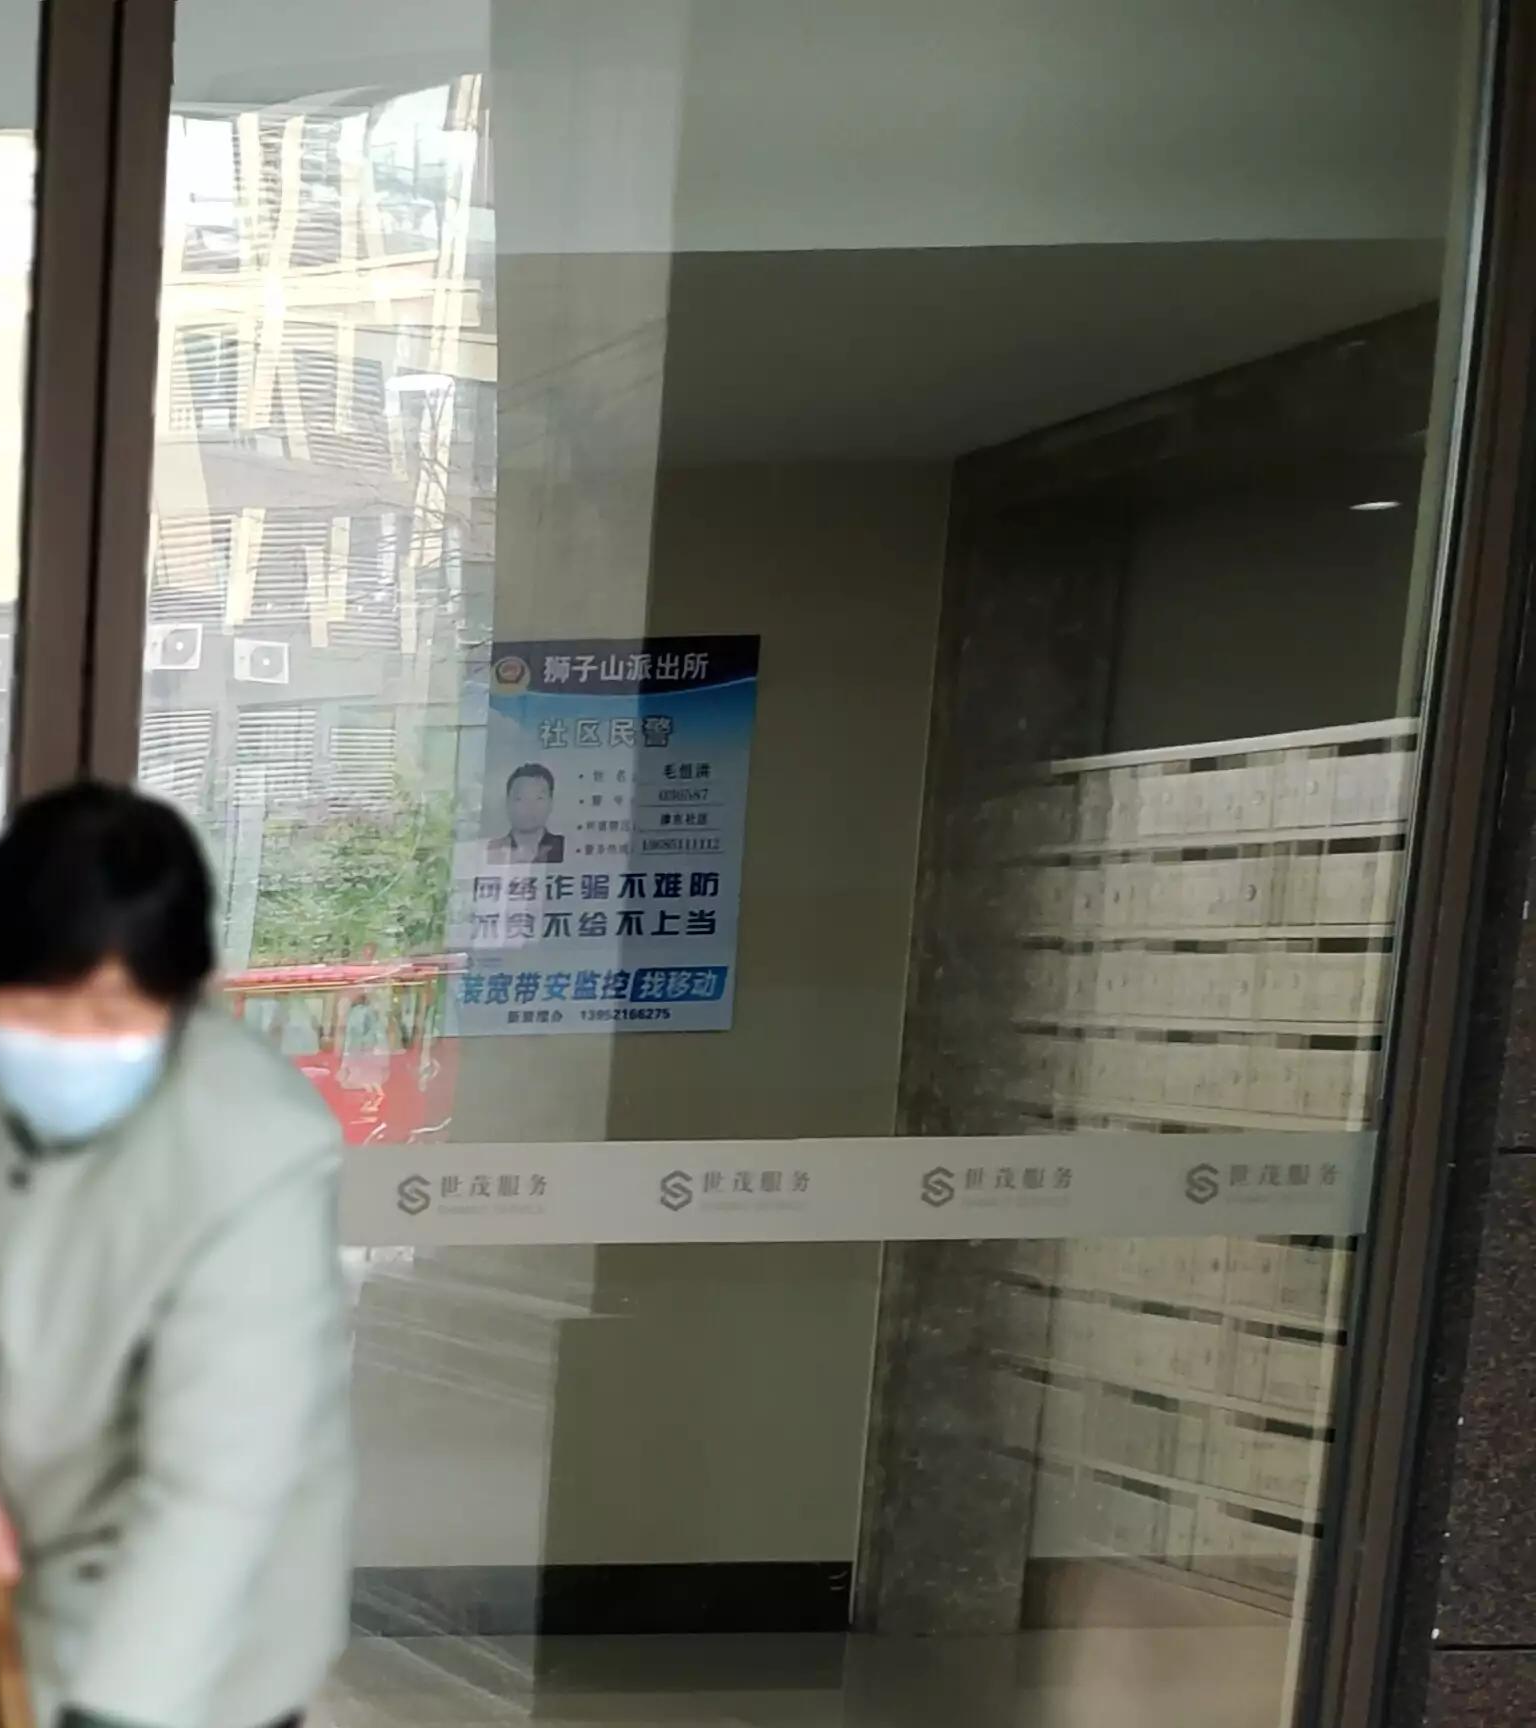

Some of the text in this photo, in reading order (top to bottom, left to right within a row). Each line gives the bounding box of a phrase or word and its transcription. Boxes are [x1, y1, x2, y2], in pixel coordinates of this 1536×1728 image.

[543, 651, 710, 684] 狮子山派出所
[539, 715, 674, 749] 社区民警
[472, 871, 721, 902] 网络诈骗不难防
[469, 908, 718, 939] 不贪不给不上当
[458, 968, 717, 1004] 装宽带安监控 找移动
[440, 1173, 547, 1198] 世茂服务
[701, 1169, 811, 1194] 世茂服务
